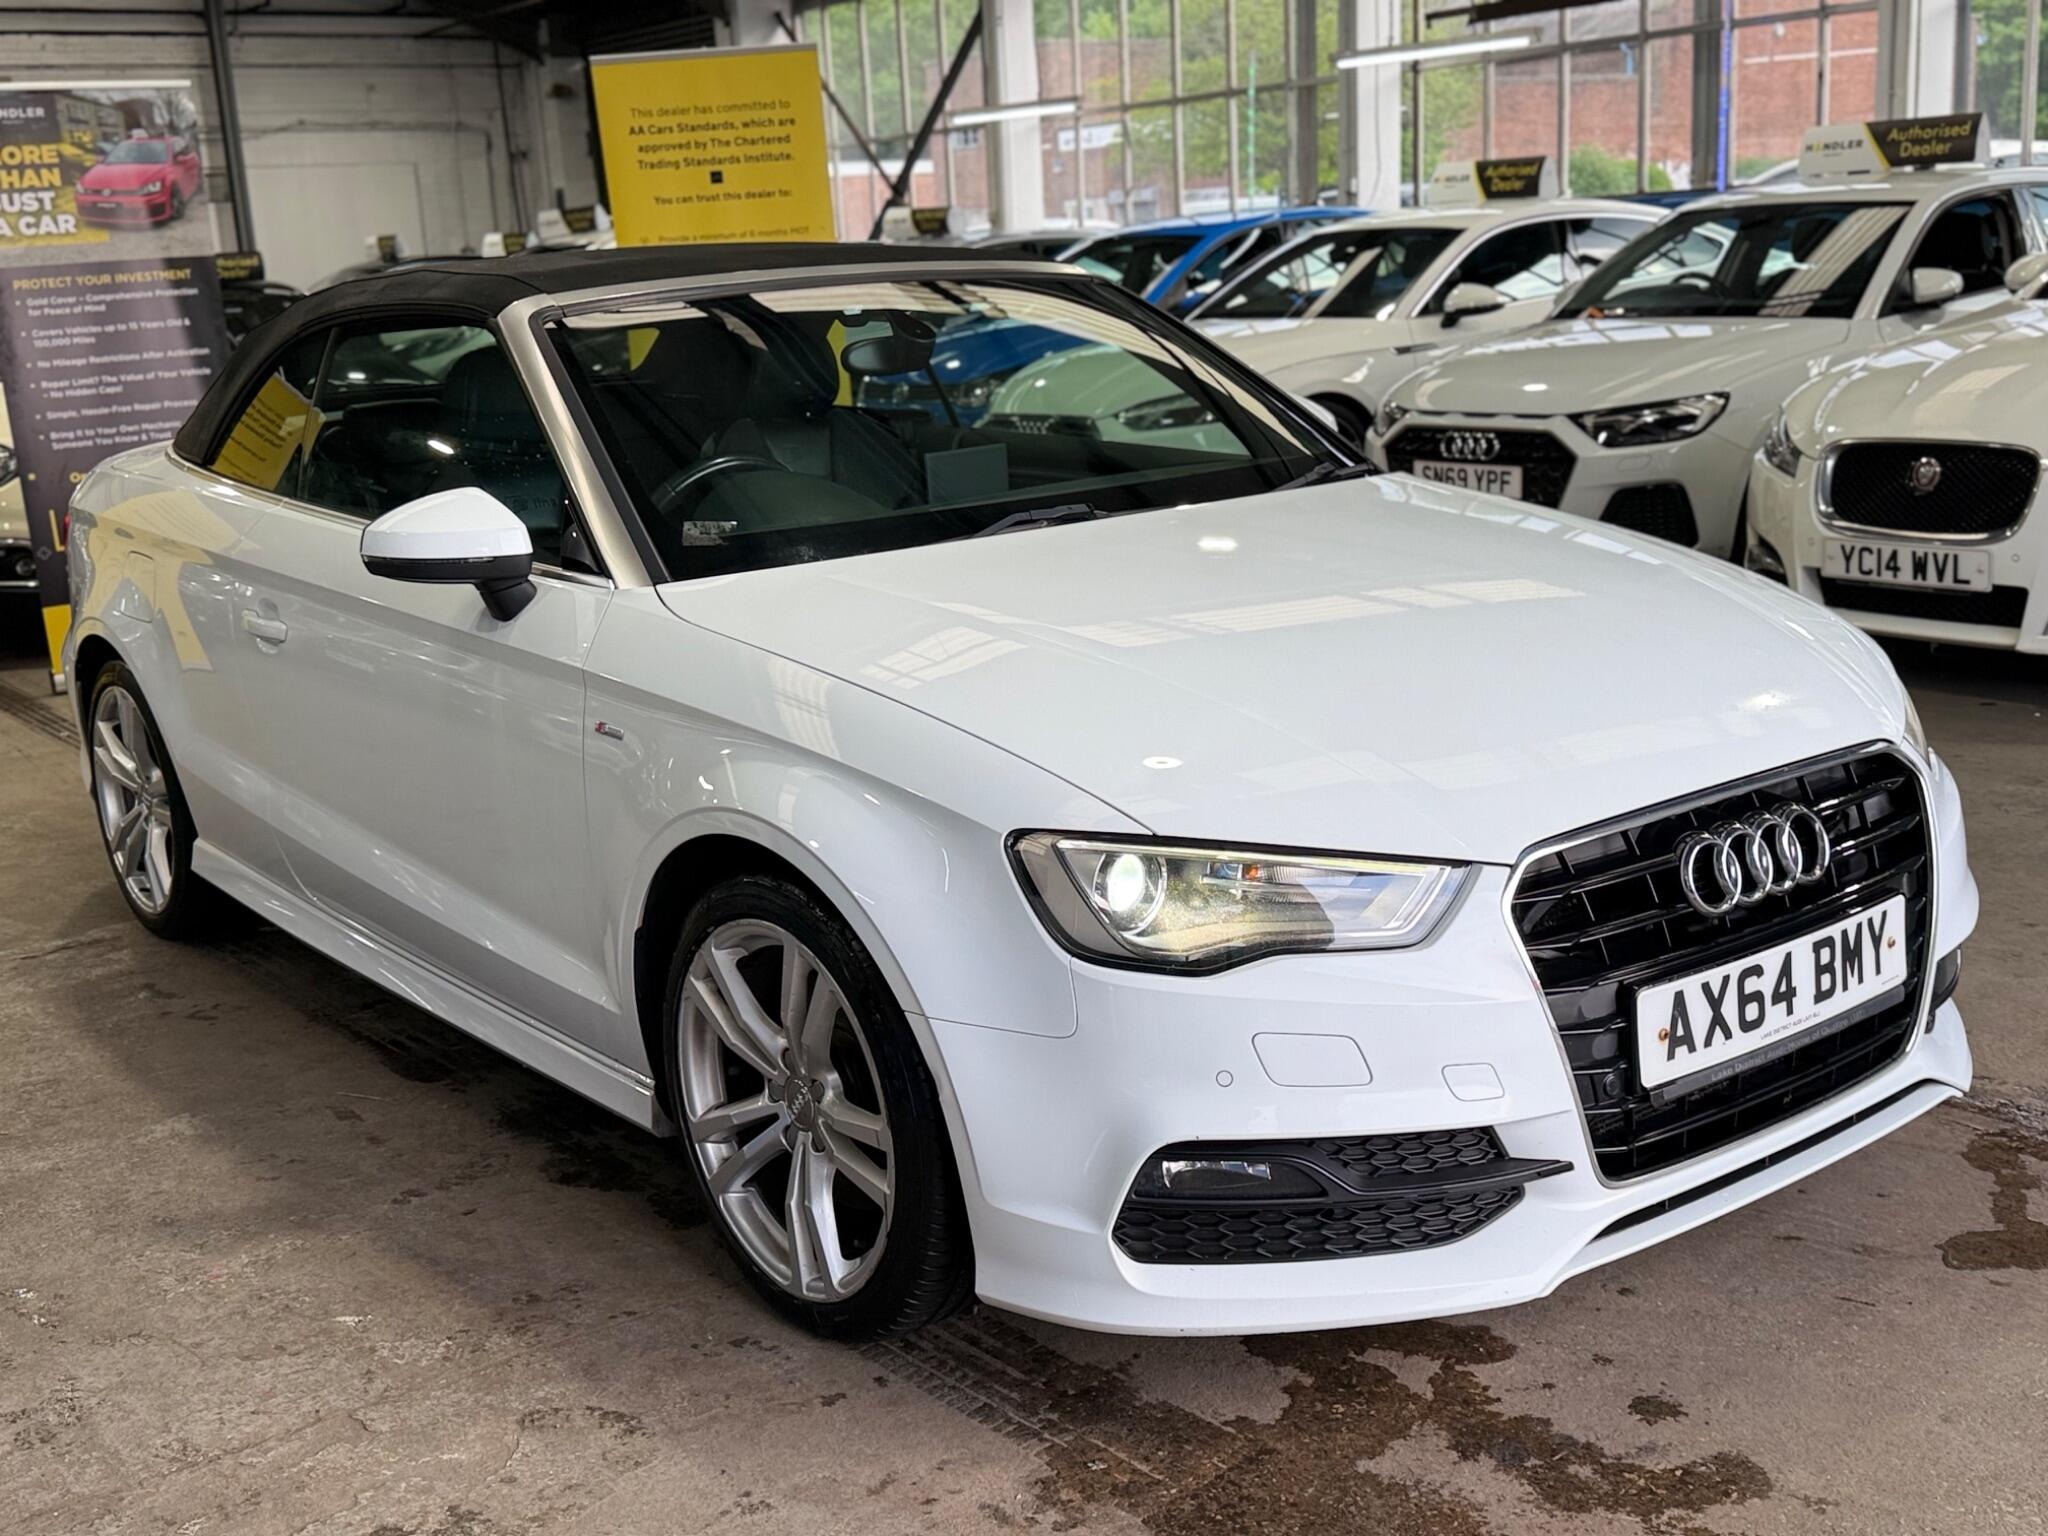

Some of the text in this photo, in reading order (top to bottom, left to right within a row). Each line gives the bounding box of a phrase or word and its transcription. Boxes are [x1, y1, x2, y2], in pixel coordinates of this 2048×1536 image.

[0, 107, 45, 118] NDLER
[630, 99, 791, 118] This dealer has committed to
[629, 117, 796, 136] AA Cars Standards, which are
[1887, 120, 1972, 142] Authorised
[637, 133, 791, 154] approved by The Chartered
[1900, 142, 1953, 158] Dealer
[0, 144, 59, 166] ORE
[637, 152, 795, 171] Trading Standards Institute.
[0, 167, 62, 188] HAN
[0, 191, 56, 213] UST
[653, 195, 673, 206] You
[675, 195, 694, 204] can
[696, 193, 721, 203] trust
[723, 191, 743, 201] this
[744, 188, 776, 200] dealer
[18, 213, 77, 236] CAR
[658, 234, 690, 243] Provide
[757, 228, 788, 237] months
[13, 268, 192, 291] PROTECT YOUR INVESTMENT
[26, 297, 49, 307] Gold
[50, 295, 77, 305] Cover
[85, 291, 153, 303] Comprehensive
[155, 287, 199, 298] Protection
[28, 303, 106, 318] for Peace of Mind
[32, 317, 191, 338] Covers Vehicles up to 15 Years Old &
[72, 335, 96, 345] Miles
[37, 347, 210, 369] No Mileage Restrictions After Activation
[41, 366, 212, 389] Repair Limit? The Value of Your Vehicle
[50, 390, 64, 399] No
[65, 387, 97, 398] Hidden
[133, 402, 162, 412] Repair
[50, 431, 75, 441] Bring
[84, 428, 95, 438] to
[96, 427, 117, 436] Your
[119, 424, 140, 434] Own
[51, 431, 172, 451] Someone You Know & Trust
[1422, 465, 1512, 495] SN69 YPF
[1840, 544, 1971, 585] YC14 WVL
[1666, 909, 1888, 1063] AX64 BMY
[1711, 1067, 1733, 1081] Lake
